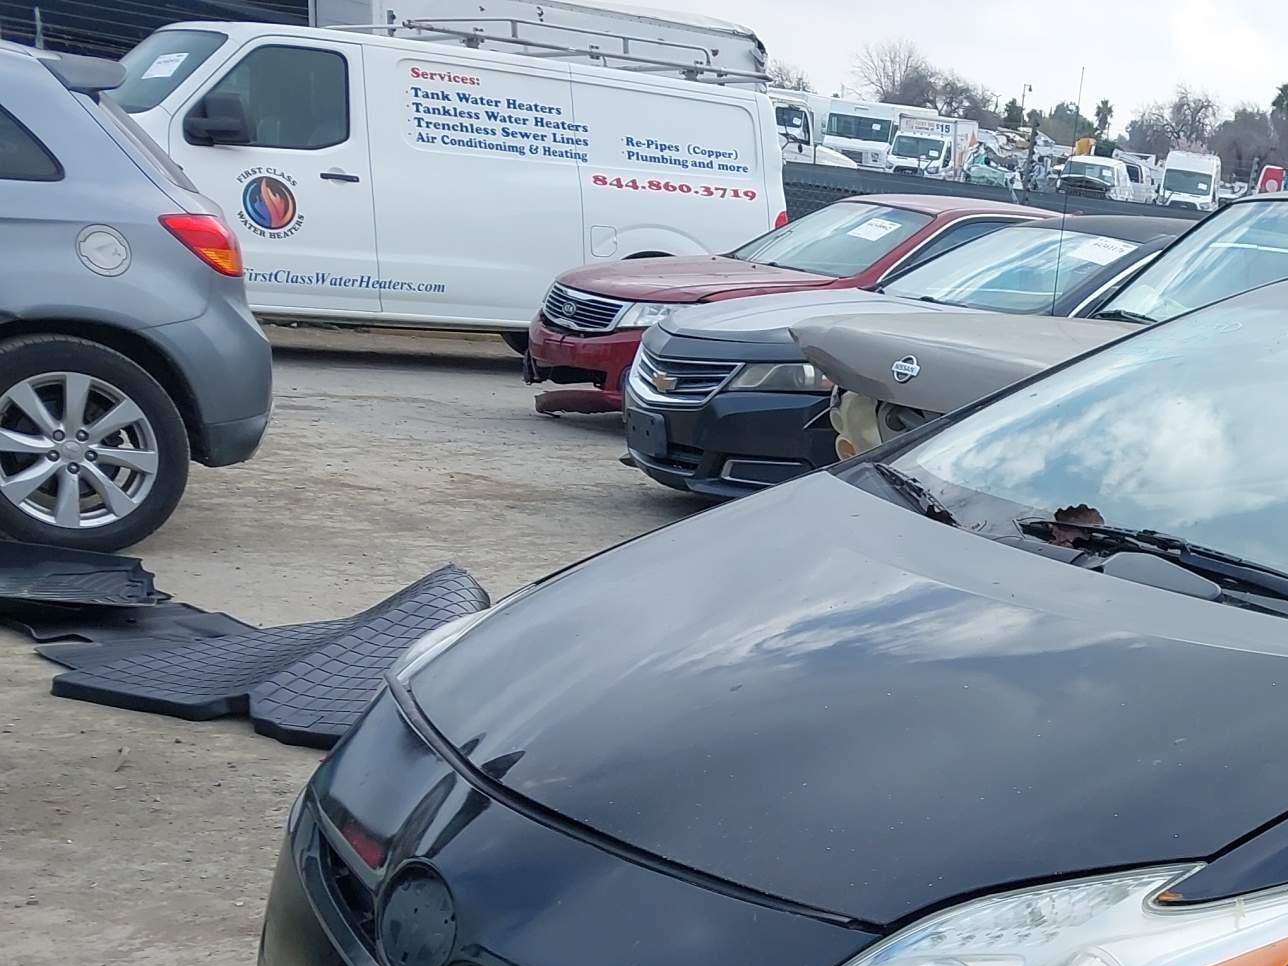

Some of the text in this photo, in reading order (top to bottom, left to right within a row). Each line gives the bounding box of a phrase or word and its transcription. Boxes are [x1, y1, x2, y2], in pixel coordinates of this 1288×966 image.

[410, 66, 481, 86] Services:
[411, 86, 562, 116] Tank Water Heaters
[412, 101, 589, 133] Tankless Water Heaters
[413, 116, 589, 147] Trenchless Sewer Lines
[416, 131, 438, 144] Air
[529, 144, 539, 155] &
[542, 145, 588, 163] Heating
[625, 136, 739, 161] Re-Pipes (Copper)
[626, 150, 749, 173] Plumbing and more
[236, 166, 298, 187] FIRST CLASS
[591, 174, 757, 201] 844.860.3719
[237, 210, 305, 240] WATER HEATERS
[243, 267, 446, 293] irstClassWaterHeaters.com
